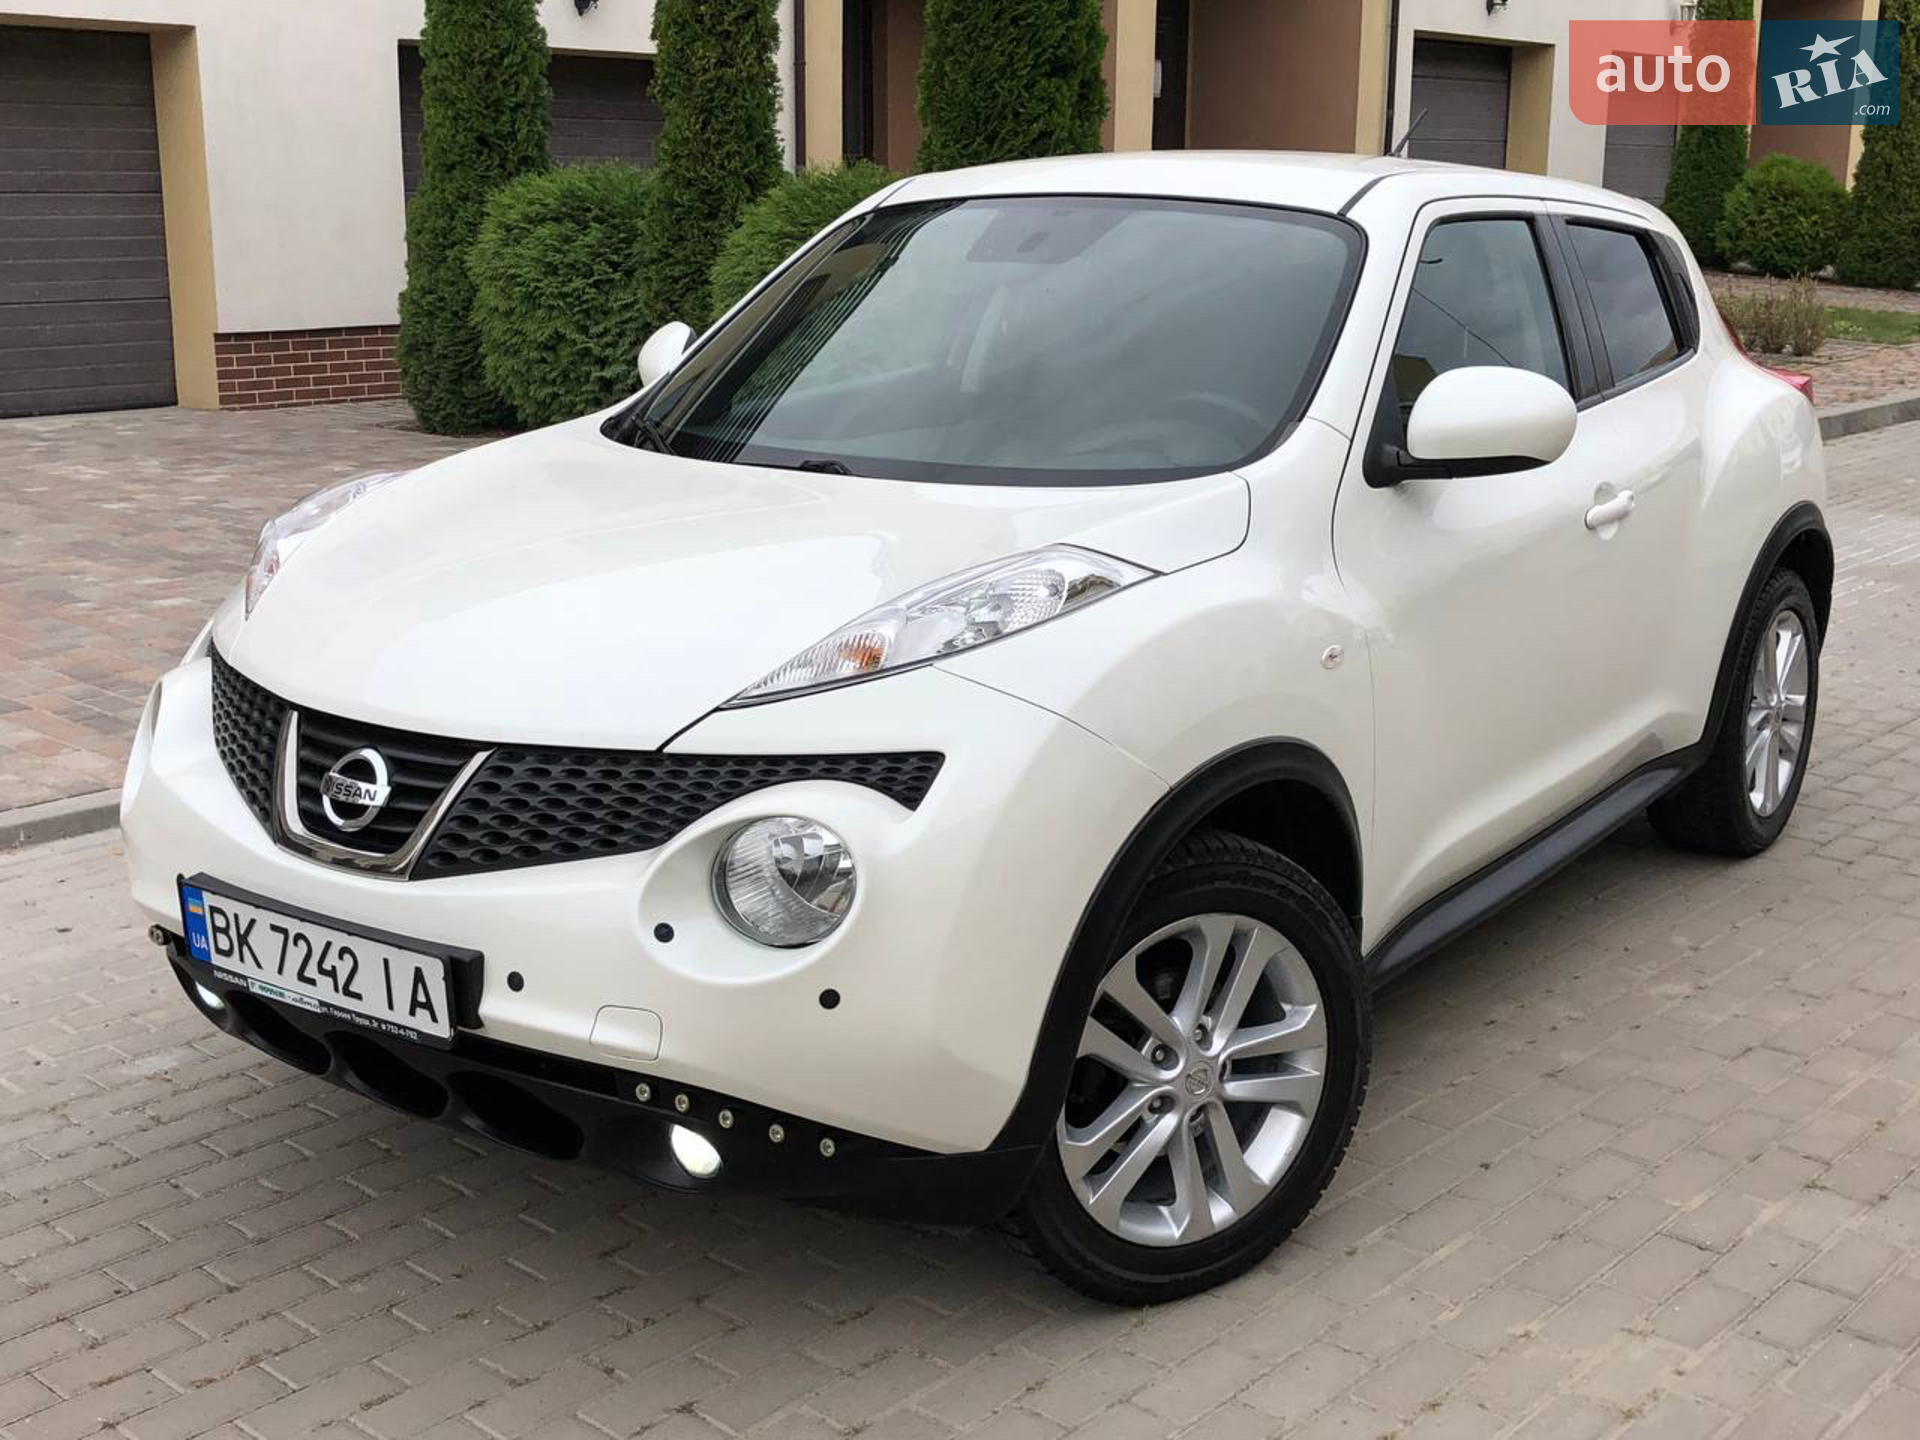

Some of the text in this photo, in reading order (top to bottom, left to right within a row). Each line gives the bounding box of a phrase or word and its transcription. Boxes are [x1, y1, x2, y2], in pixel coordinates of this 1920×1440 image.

[323, 776, 378, 802] NISSAN
[191, 932, 209, 951] UA
[208, 905, 439, 1024] BK 7242 IA
